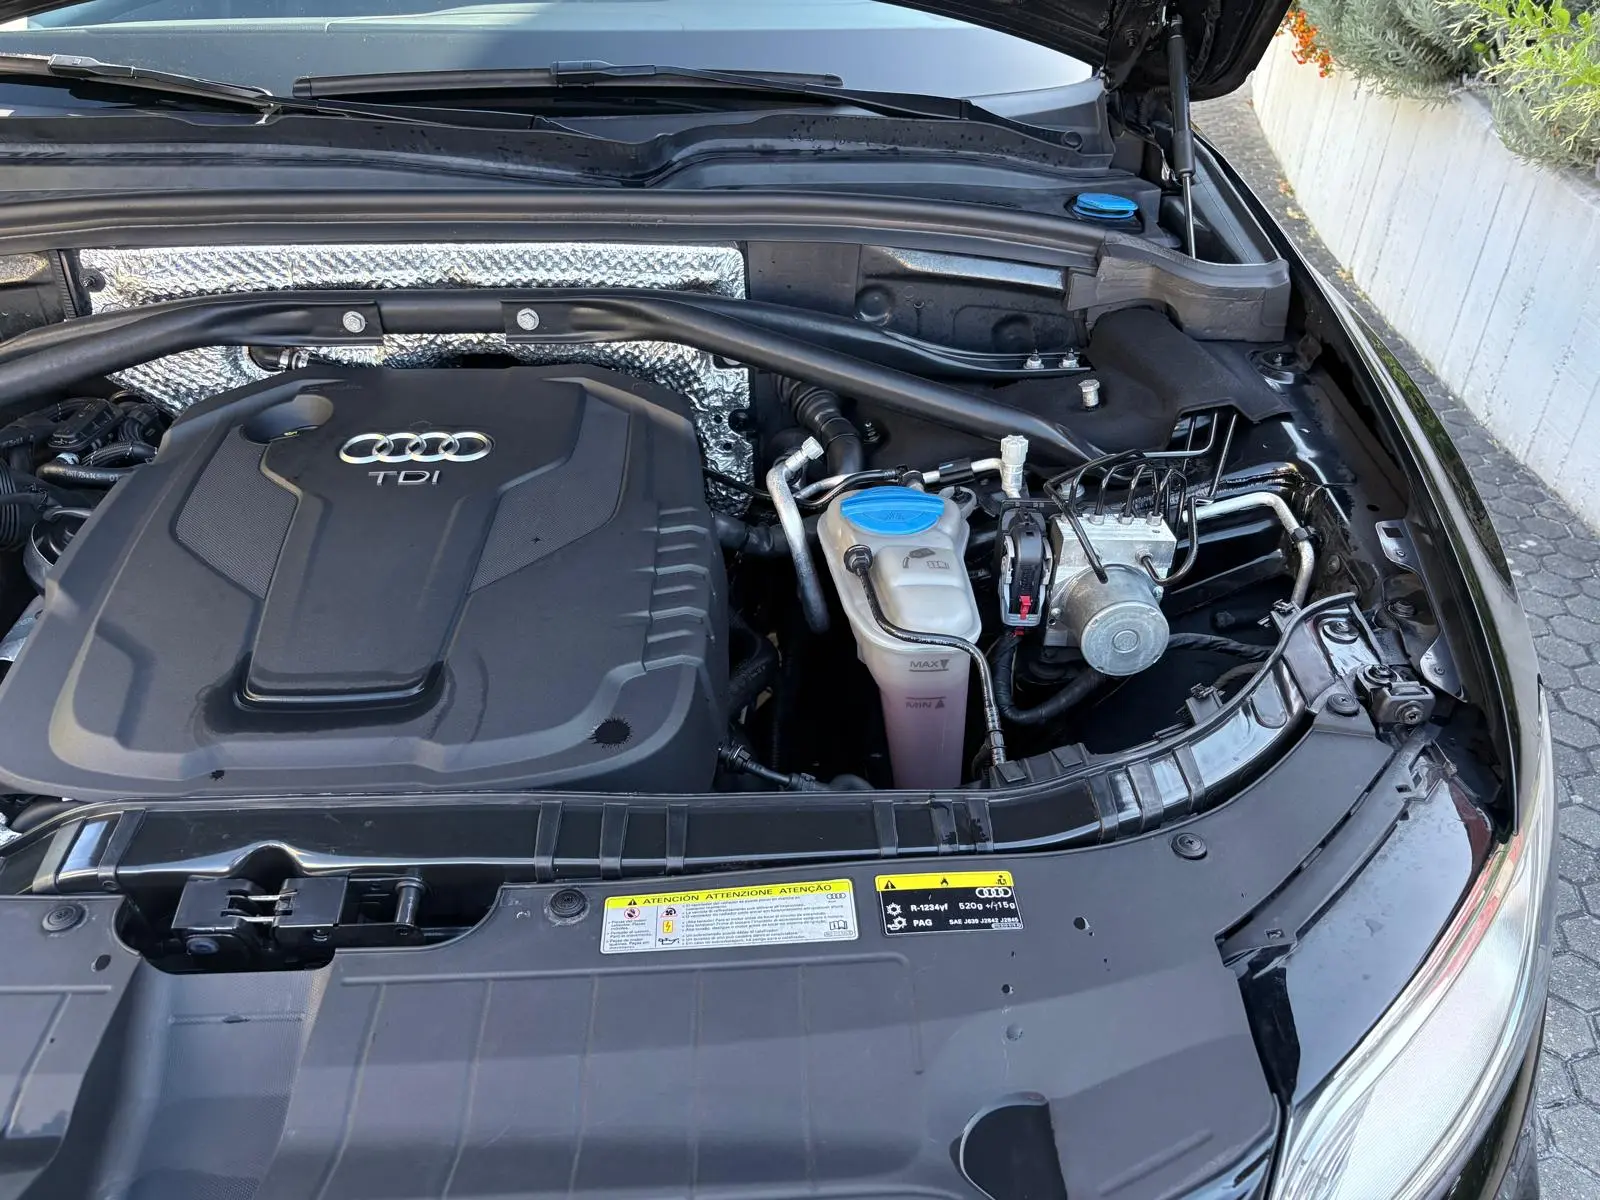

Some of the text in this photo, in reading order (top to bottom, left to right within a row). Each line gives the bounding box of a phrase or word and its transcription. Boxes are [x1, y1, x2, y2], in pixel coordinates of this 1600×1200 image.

[368, 470, 440, 486] TDI
[910, 660, 939, 668] MAX
[905, 701, 932, 709] MIN
[642, 894, 699, 905] ATENCIÓN
[705, 888, 773, 900] ATTENZIONE
[779, 884, 832, 894] ATENÇÃO
[910, 902, 948, 912] R-1234yf
[958, 902, 983, 911] 520g
[912, 919, 933, 927] PAG
